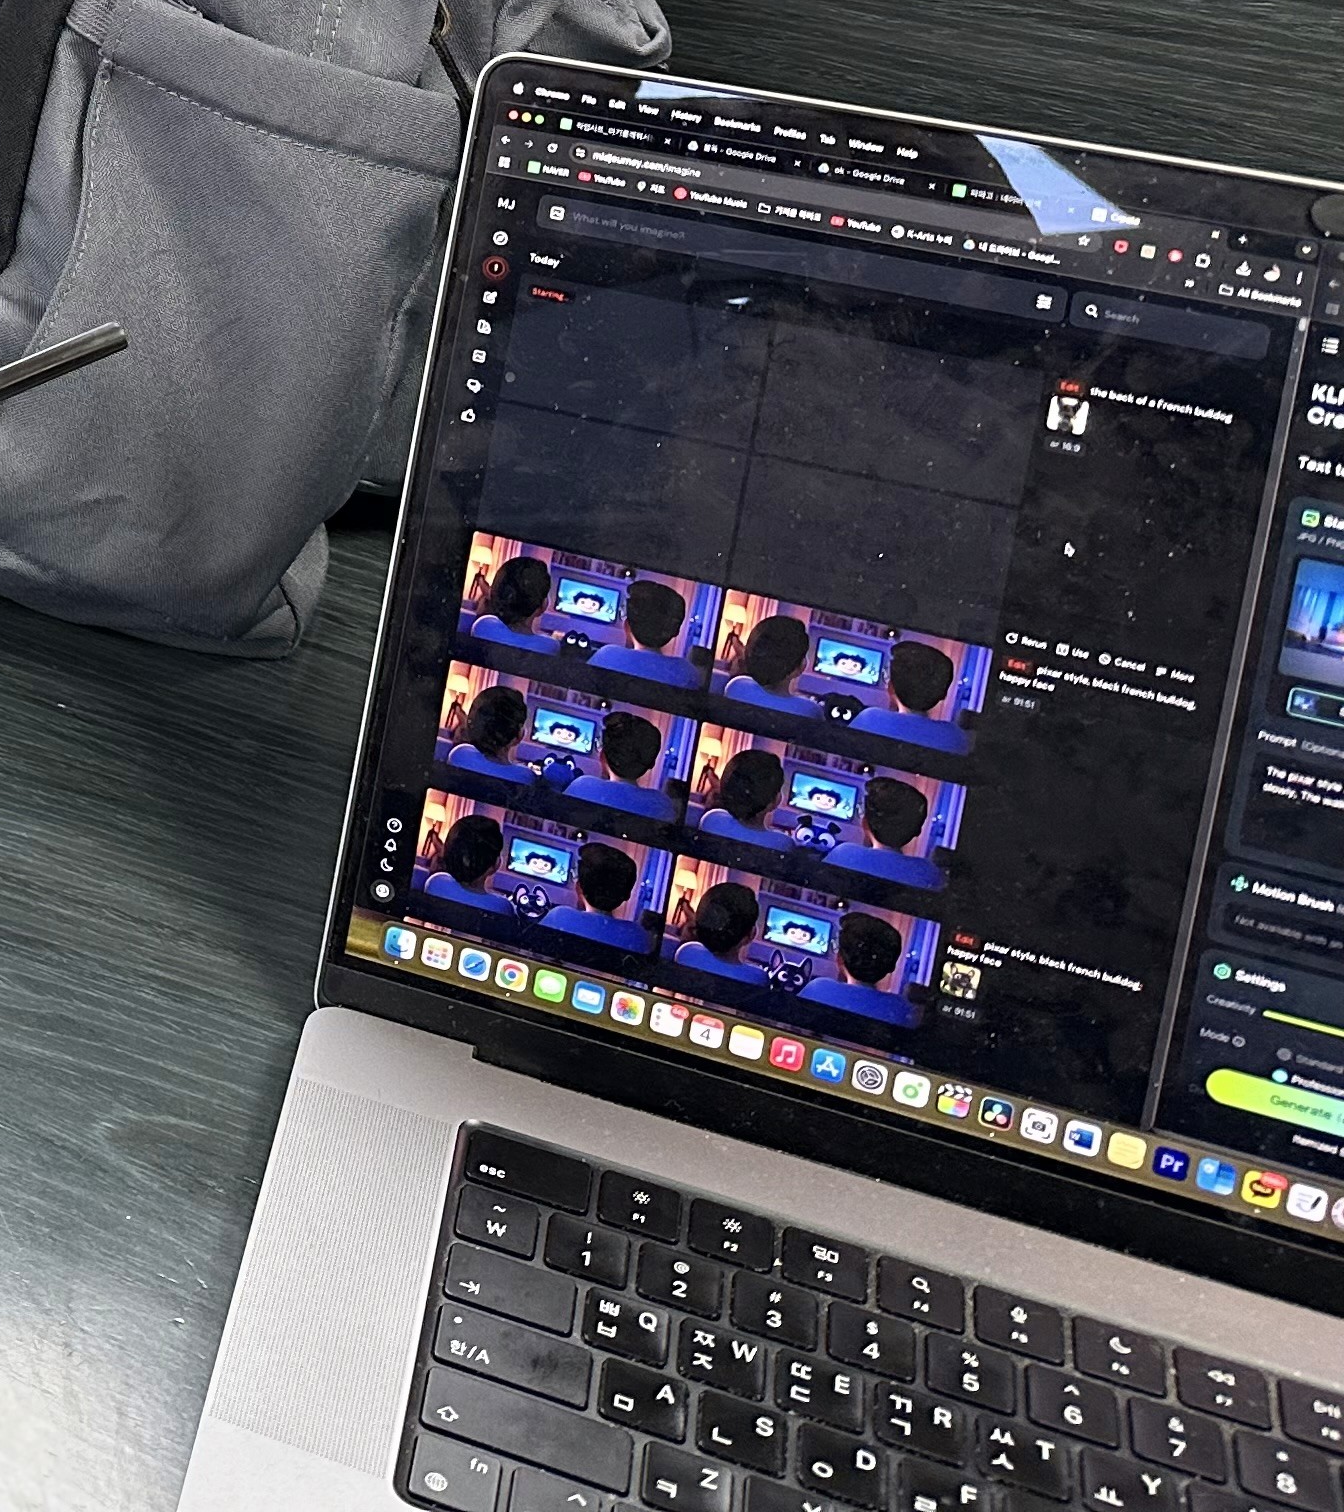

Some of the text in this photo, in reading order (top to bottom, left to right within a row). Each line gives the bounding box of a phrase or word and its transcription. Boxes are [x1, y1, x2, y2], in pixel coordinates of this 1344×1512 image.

[534, 86, 919, 161] Chrome File Edit View History Bookmarks Profiles Tab Window Help
[725, 147, 754, 160] Google
[593, 173, 626, 187] YouTube
[852, 169, 882, 182] Google
[497, 197, 516, 211] MJ
[689, 190, 723, 205] YouTube
[573, 211, 599, 225] What
[601, 216, 618, 228] will
[619, 221, 638, 233] you
[847, 218, 881, 234] YouTube
[529, 252, 560, 269] Today
[1104, 309, 1140, 325] Search
[1090, 387, 1108, 399] the
[1109, 390, 1134, 404] back
[1135, 394, 1148, 406] of
[1298, 455, 1331, 476] Text
[1021, 636, 1047, 650] Rerun
[1071, 647, 1090, 660] Use
[1114, 656, 1146, 672] Cancel
[999, 670, 1055, 692] happy face
[1036, 665, 1062, 679] pixar
[1092, 677, 1120, 693] black
[1170, 669, 1195, 683] More
[1257, 729, 1298, 748] Prompt
[1266, 765, 1287, 780] The
[1251, 880, 1335, 913] Motion Brush
[946, 945, 1003, 968] happy face
[983, 941, 1010, 955] pixar
[1038, 954, 1066, 970] black
[1067, 962, 1100, 980] french
[1234, 968, 1287, 993] Settings
[699, 1028, 711, 1042] 4
[1198, 1026, 1230, 1044] Mode
[1269, 1093, 1333, 1121] Generate
[479, 1163, 506, 1179] esc
[1160, 1153, 1184, 1174] Pr
[632, 1212, 646, 1224] F1
[723, 1239, 739, 1253] F2
[581, 1250, 592, 1267] 1
[672, 1280, 688, 1298] 2
[637, 1311, 658, 1333] Q
[765, 1311, 782, 1328] 3
[450, 1339, 490, 1365] 한/A
[731, 1340, 758, 1363] W
[862, 1342, 880, 1360] 4
[834, 1373, 851, 1395] E
[962, 1372, 980, 1392] 5
[655, 1383, 675, 1405] A
[933, 1406, 952, 1429] R
[1063, 1404, 1083, 1425] 6
[755, 1416, 774, 1437] S
[1035, 1439, 1056, 1461] T
[1168, 1437, 1187, 1457] 7
[469, 1456, 489, 1474] fn
[855, 1448, 877, 1471] D
[700, 1467, 720, 1491] Z
[1141, 1473, 1161, 1496] Y
[1276, 1471, 1297, 1494] 8
[960, 1484, 978, 1505] F
